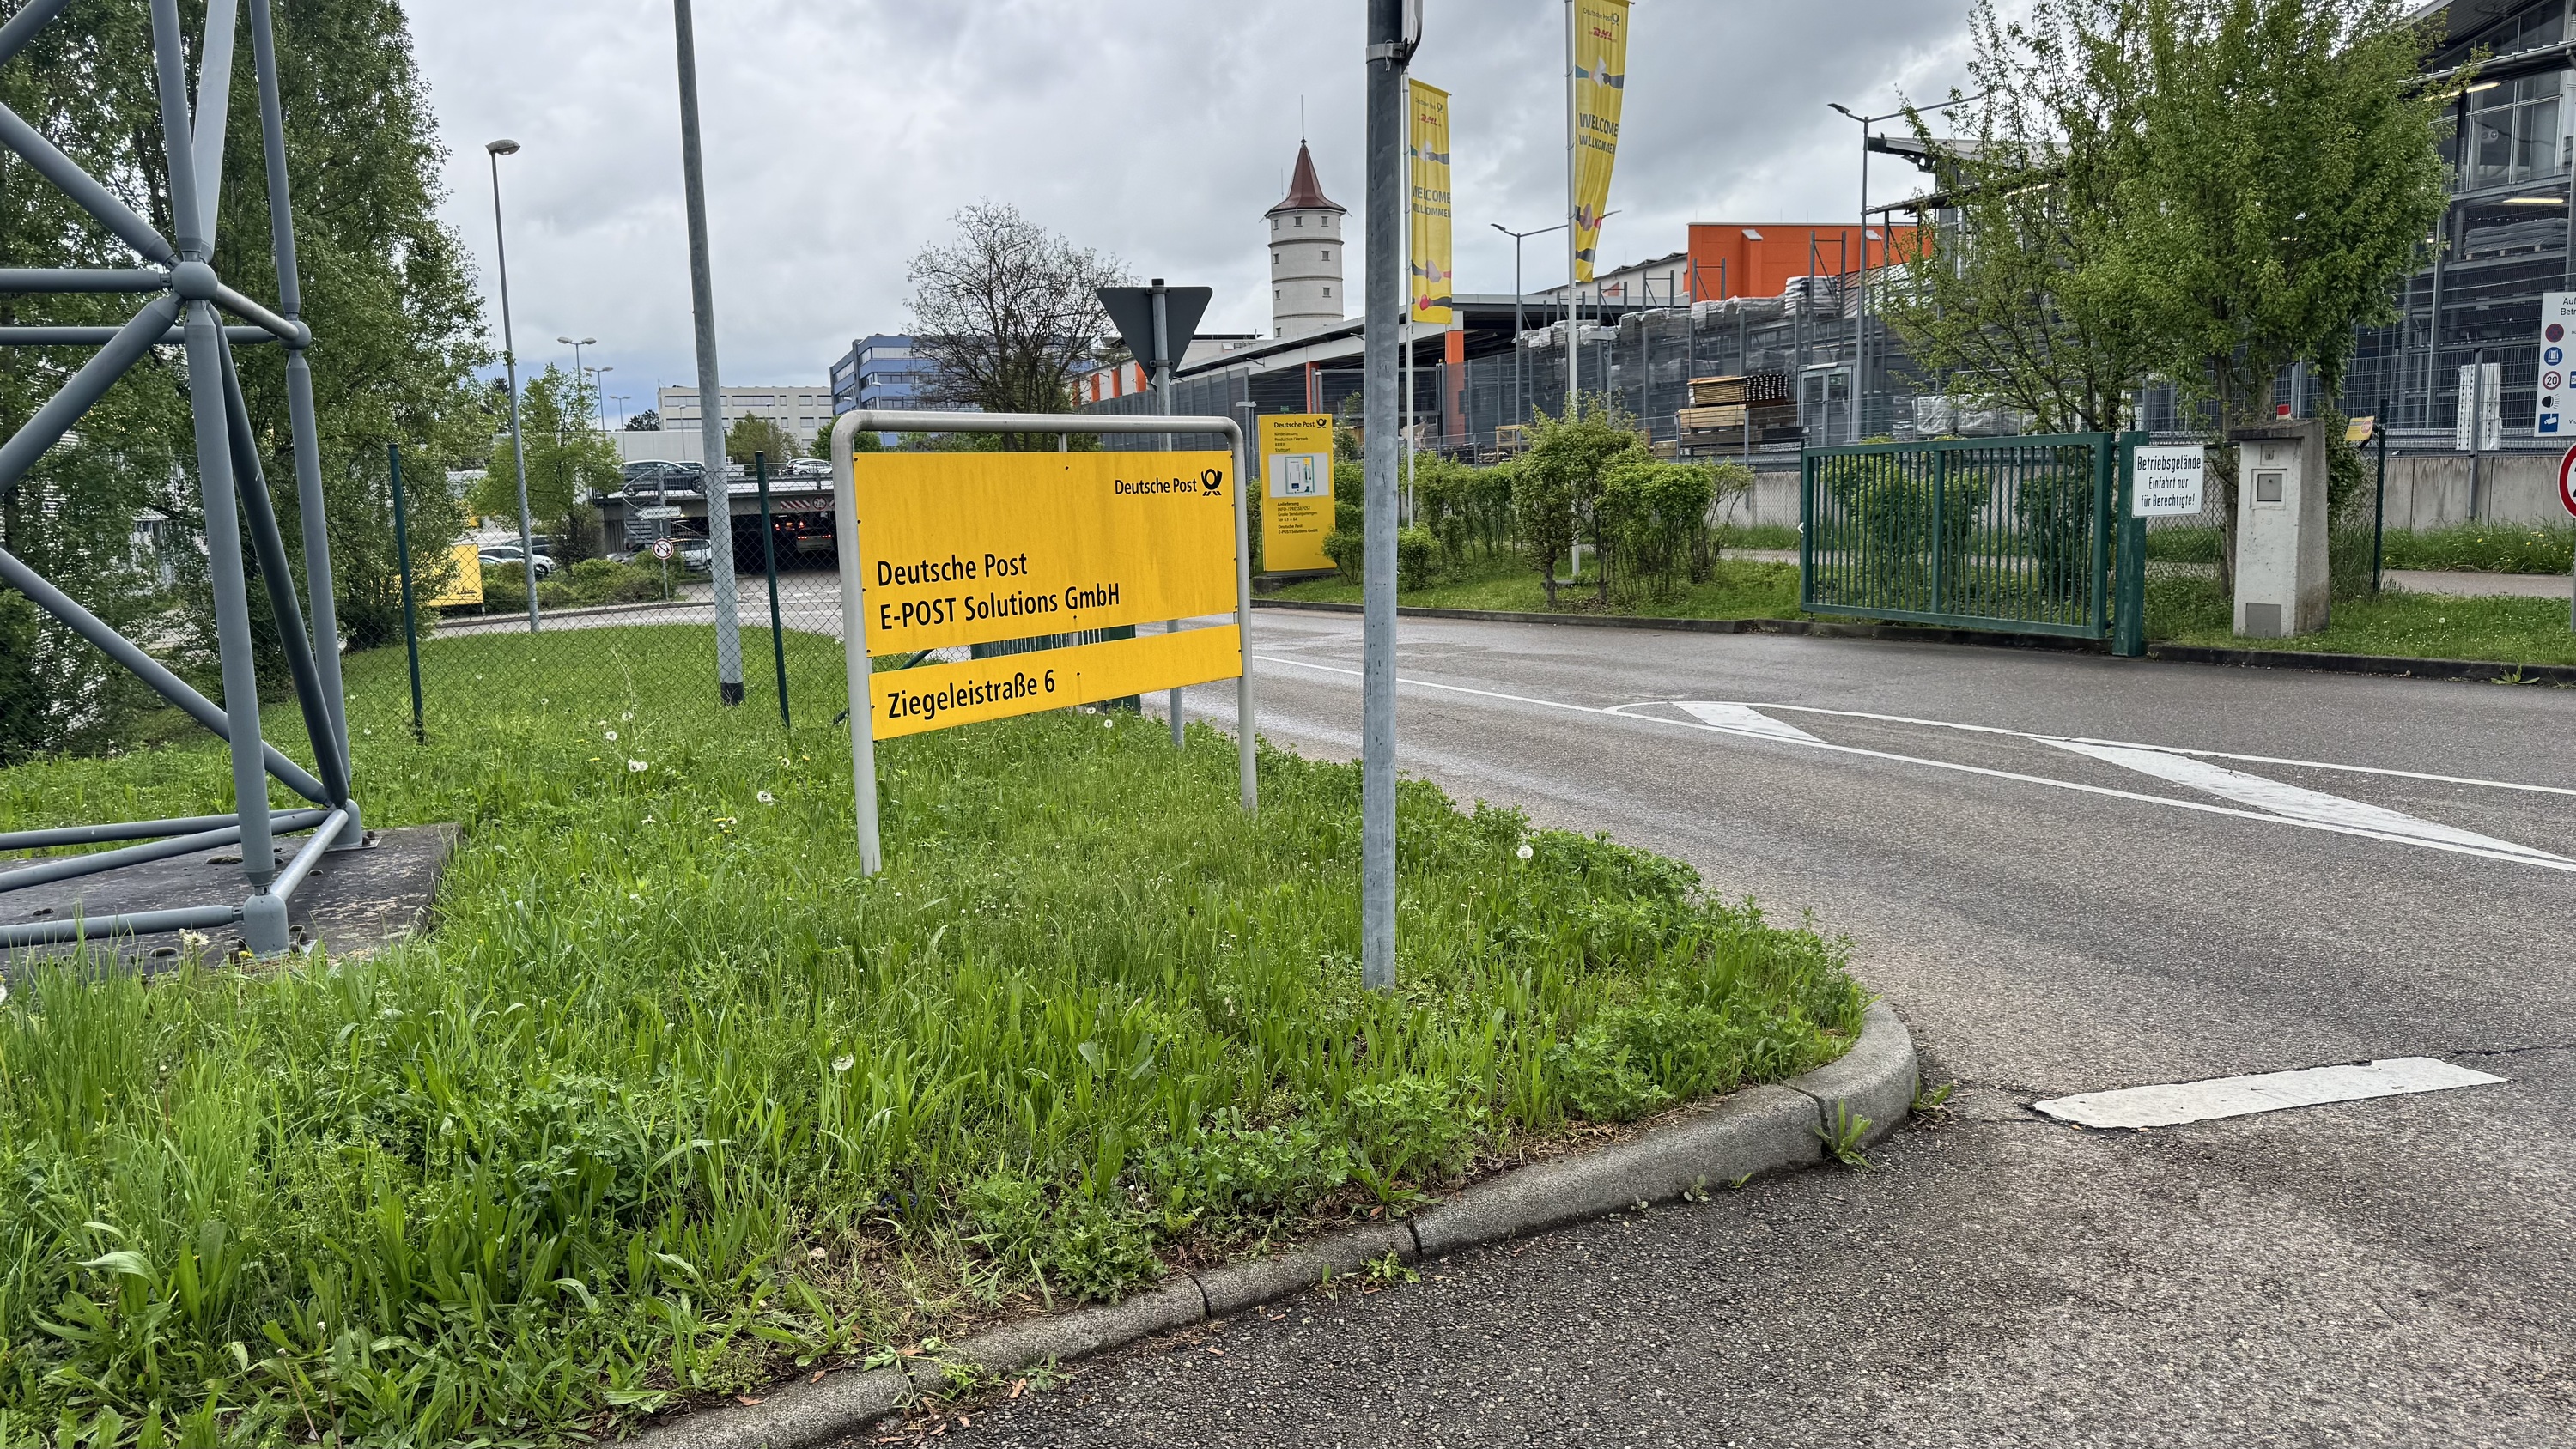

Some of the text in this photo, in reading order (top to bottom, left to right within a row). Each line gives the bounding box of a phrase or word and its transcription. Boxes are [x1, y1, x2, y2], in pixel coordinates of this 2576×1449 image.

[1578, 112, 1619, 137] WELCOME
[1578, 134, 1616, 155] WLLKOMMEN
[1412, 184, 1450, 204] WELCOME
[2546, 376, 2558, 385] 20
[2137, 454, 2201, 473] Betriebsgelände
[1115, 477, 1197, 494] Deutsche Post
[2148, 476, 2189, 489] Einfahrt nur
[2141, 493, 2196, 509] für Berechtigte!
[878, 553, 1028, 586] Deutsche Post
[880, 582, 1120, 630] E-POST Solutions GmbH
[887, 669, 1055, 720] Ziegeleistraße 6
